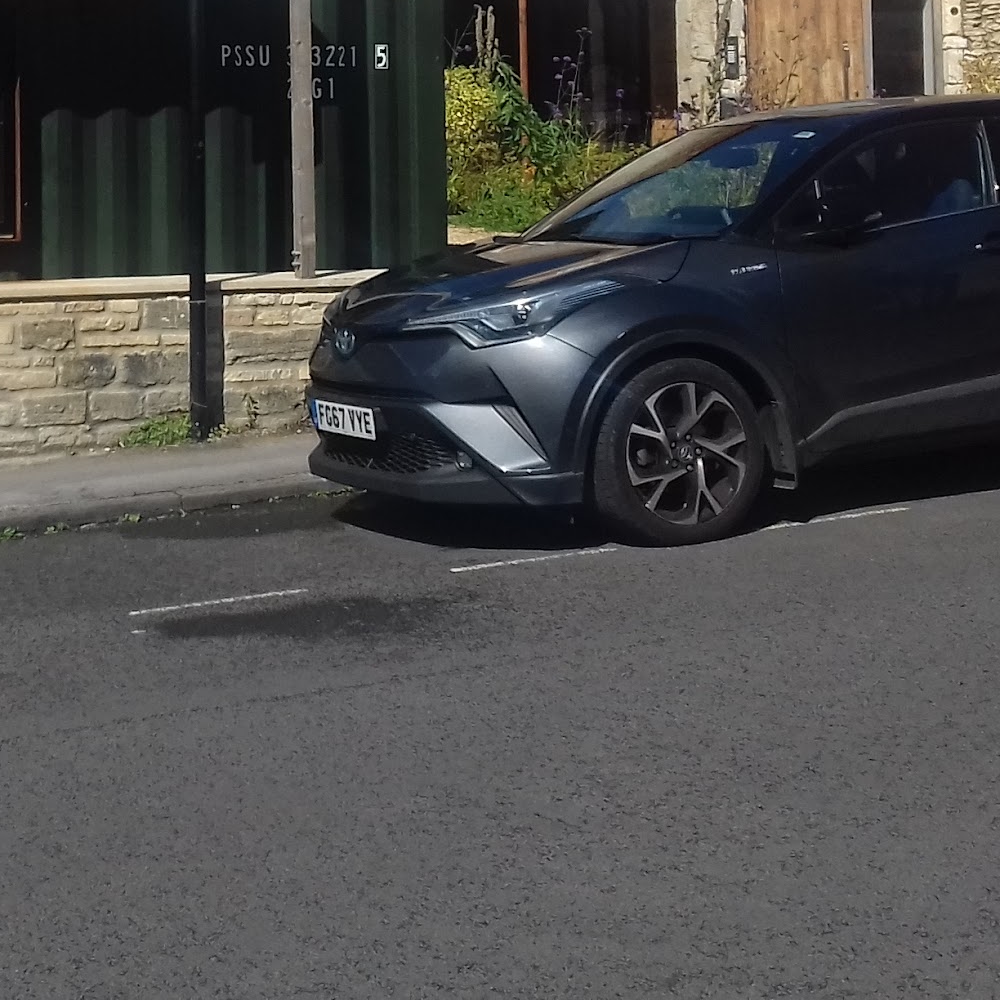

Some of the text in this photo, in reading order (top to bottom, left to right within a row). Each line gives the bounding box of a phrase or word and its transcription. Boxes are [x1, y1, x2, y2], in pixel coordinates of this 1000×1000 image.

[221, 44, 387, 68] PSSU 3221 5
[286, 76, 335, 100] 2G1
[318, 403, 373, 435] FG67 VYE
